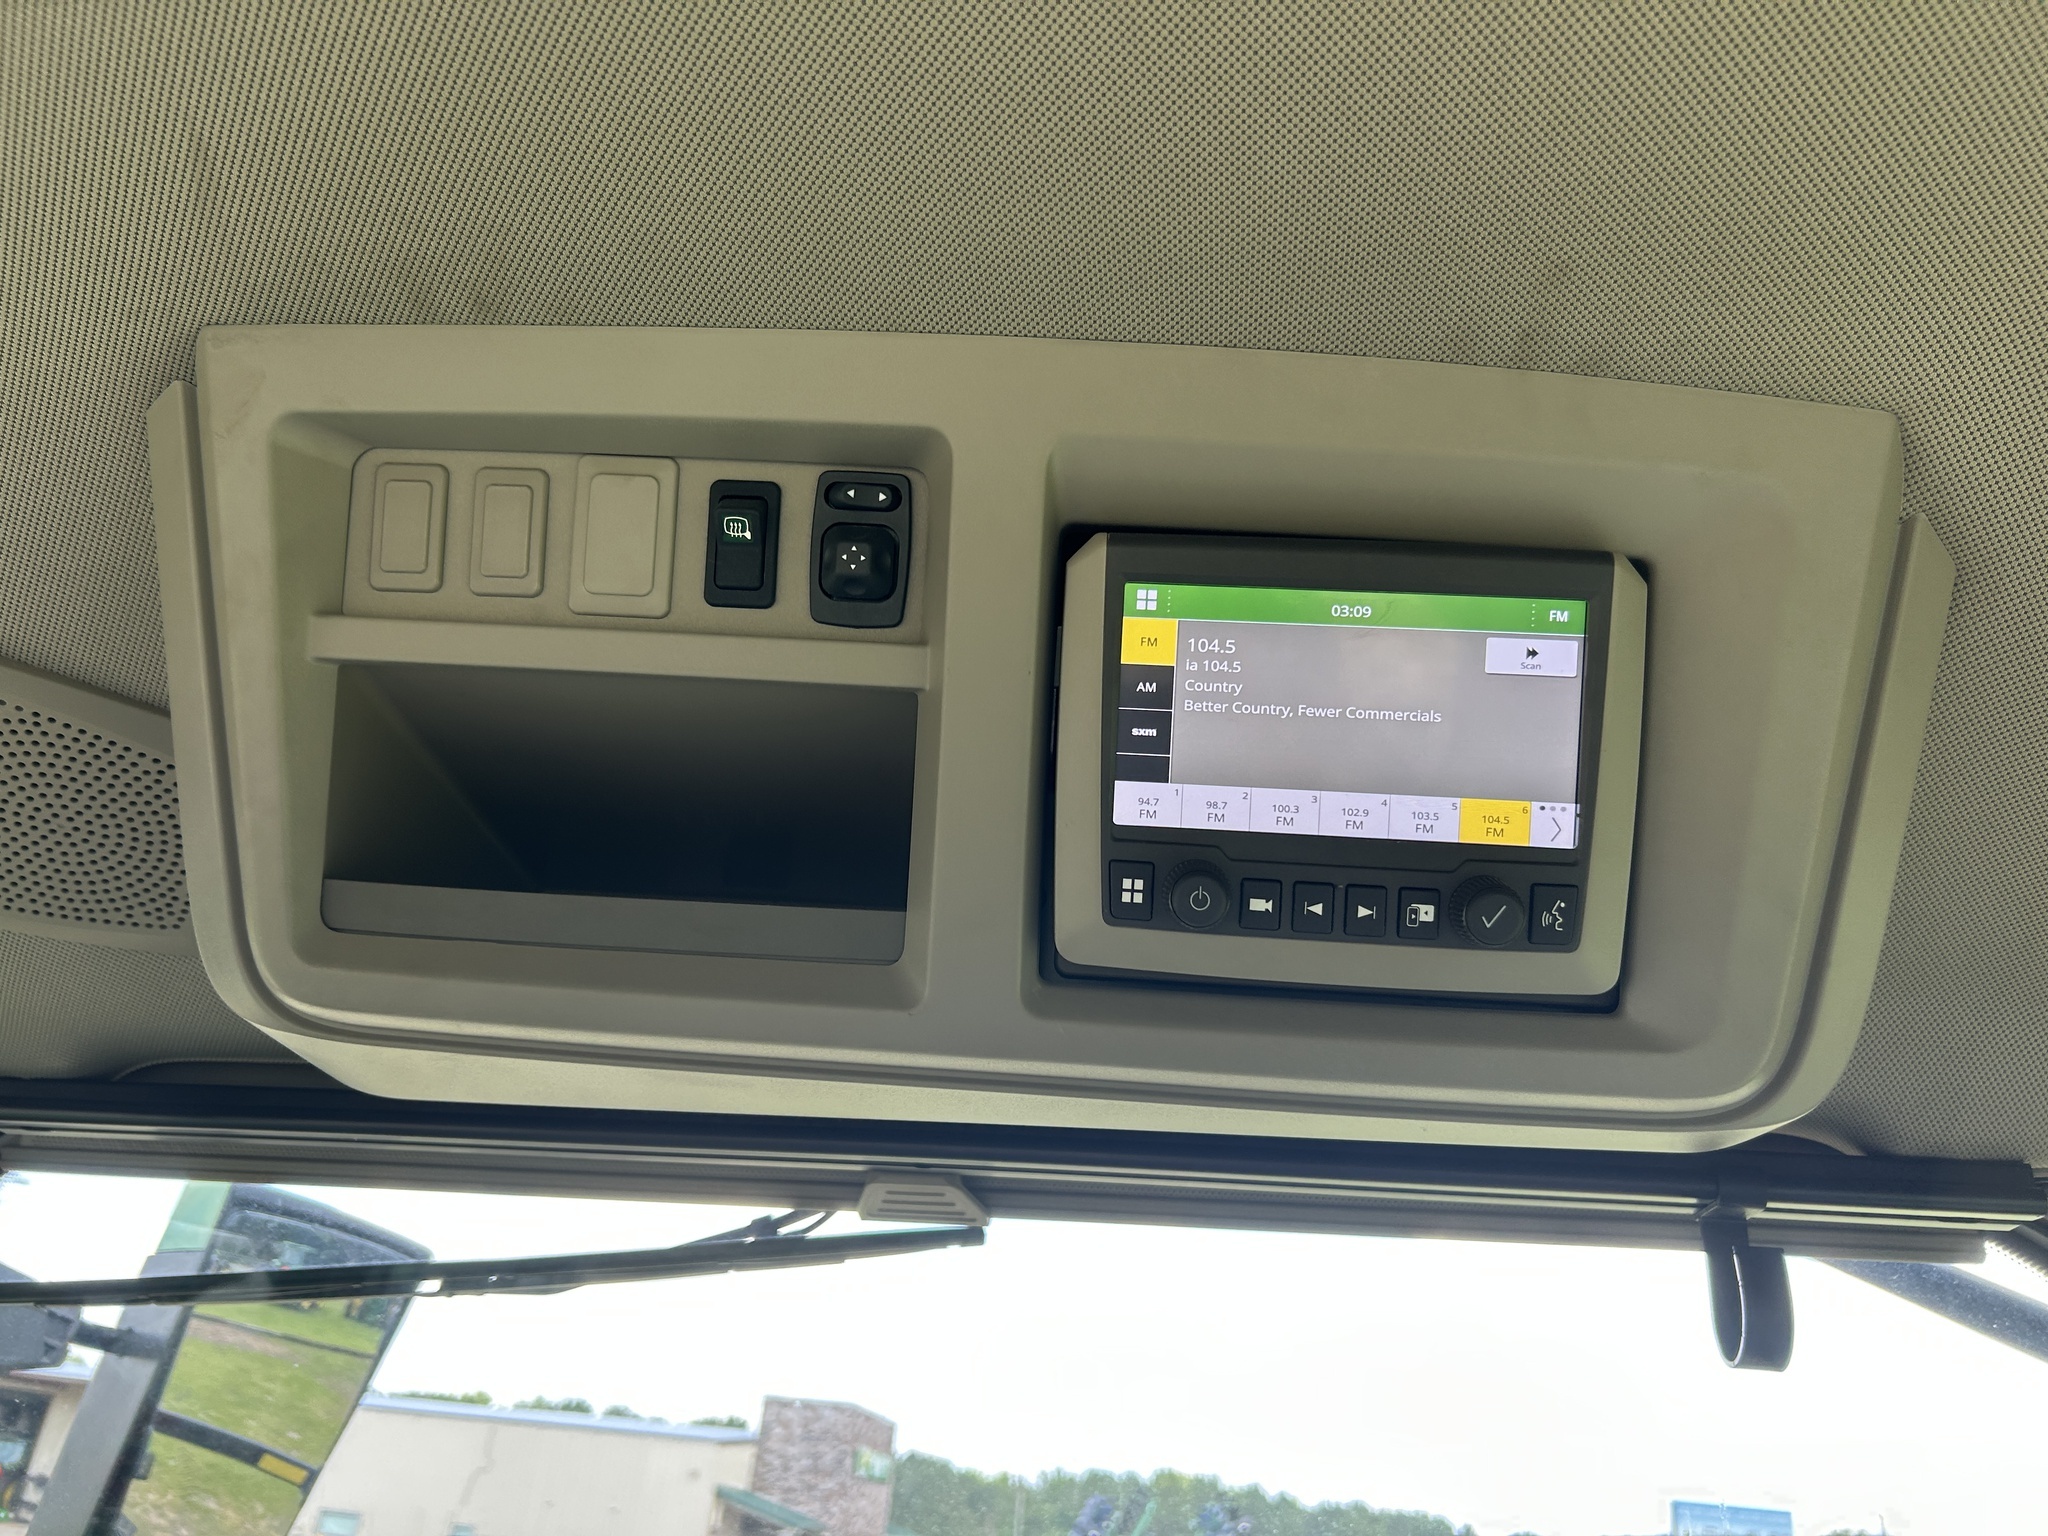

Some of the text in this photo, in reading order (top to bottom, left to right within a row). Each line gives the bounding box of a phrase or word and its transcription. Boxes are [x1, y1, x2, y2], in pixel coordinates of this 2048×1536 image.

[1331, 604, 1372, 619] 03:09
[1549, 610, 1568, 623] FM
[1140, 636, 1158, 647] FM
[1187, 637, 1236, 655] 104.5
[1185, 659, 1242, 674] ia 104.5
[1520, 661, 1542, 671] Scan
[1136, 682, 1157, 693] AM
[1184, 679, 1243, 695] Country
[1184, 699, 1442, 723] Better Country, Fewer Commercials
[1131, 727, 1157, 737] sxm
[1174, 788, 1180, 797] 1
[1242, 791, 1249, 800] 2
[1138, 797, 1159, 807] 94.7
[1311, 795, 1318, 803] 3
[1381, 799, 1388, 807] 4
[1206, 800, 1228, 811] 98.7
[1272, 804, 1300, 815] 100.3
[1451, 802, 1458, 811] 5
[1522, 806, 1529, 815] 6
[1139, 809, 1158, 820] FM
[1207, 812, 1225, 824] FM
[1341, 807, 1370, 818] 102.9
[1411, 811, 1440, 822] 103.5
[1276, 816, 1294, 827] FM
[1345, 820, 1364, 831] FM
[1481, 814, 1510, 826] 104.5
[1415, 823, 1434, 835] FM
[1485, 827, 1505, 839] FM
